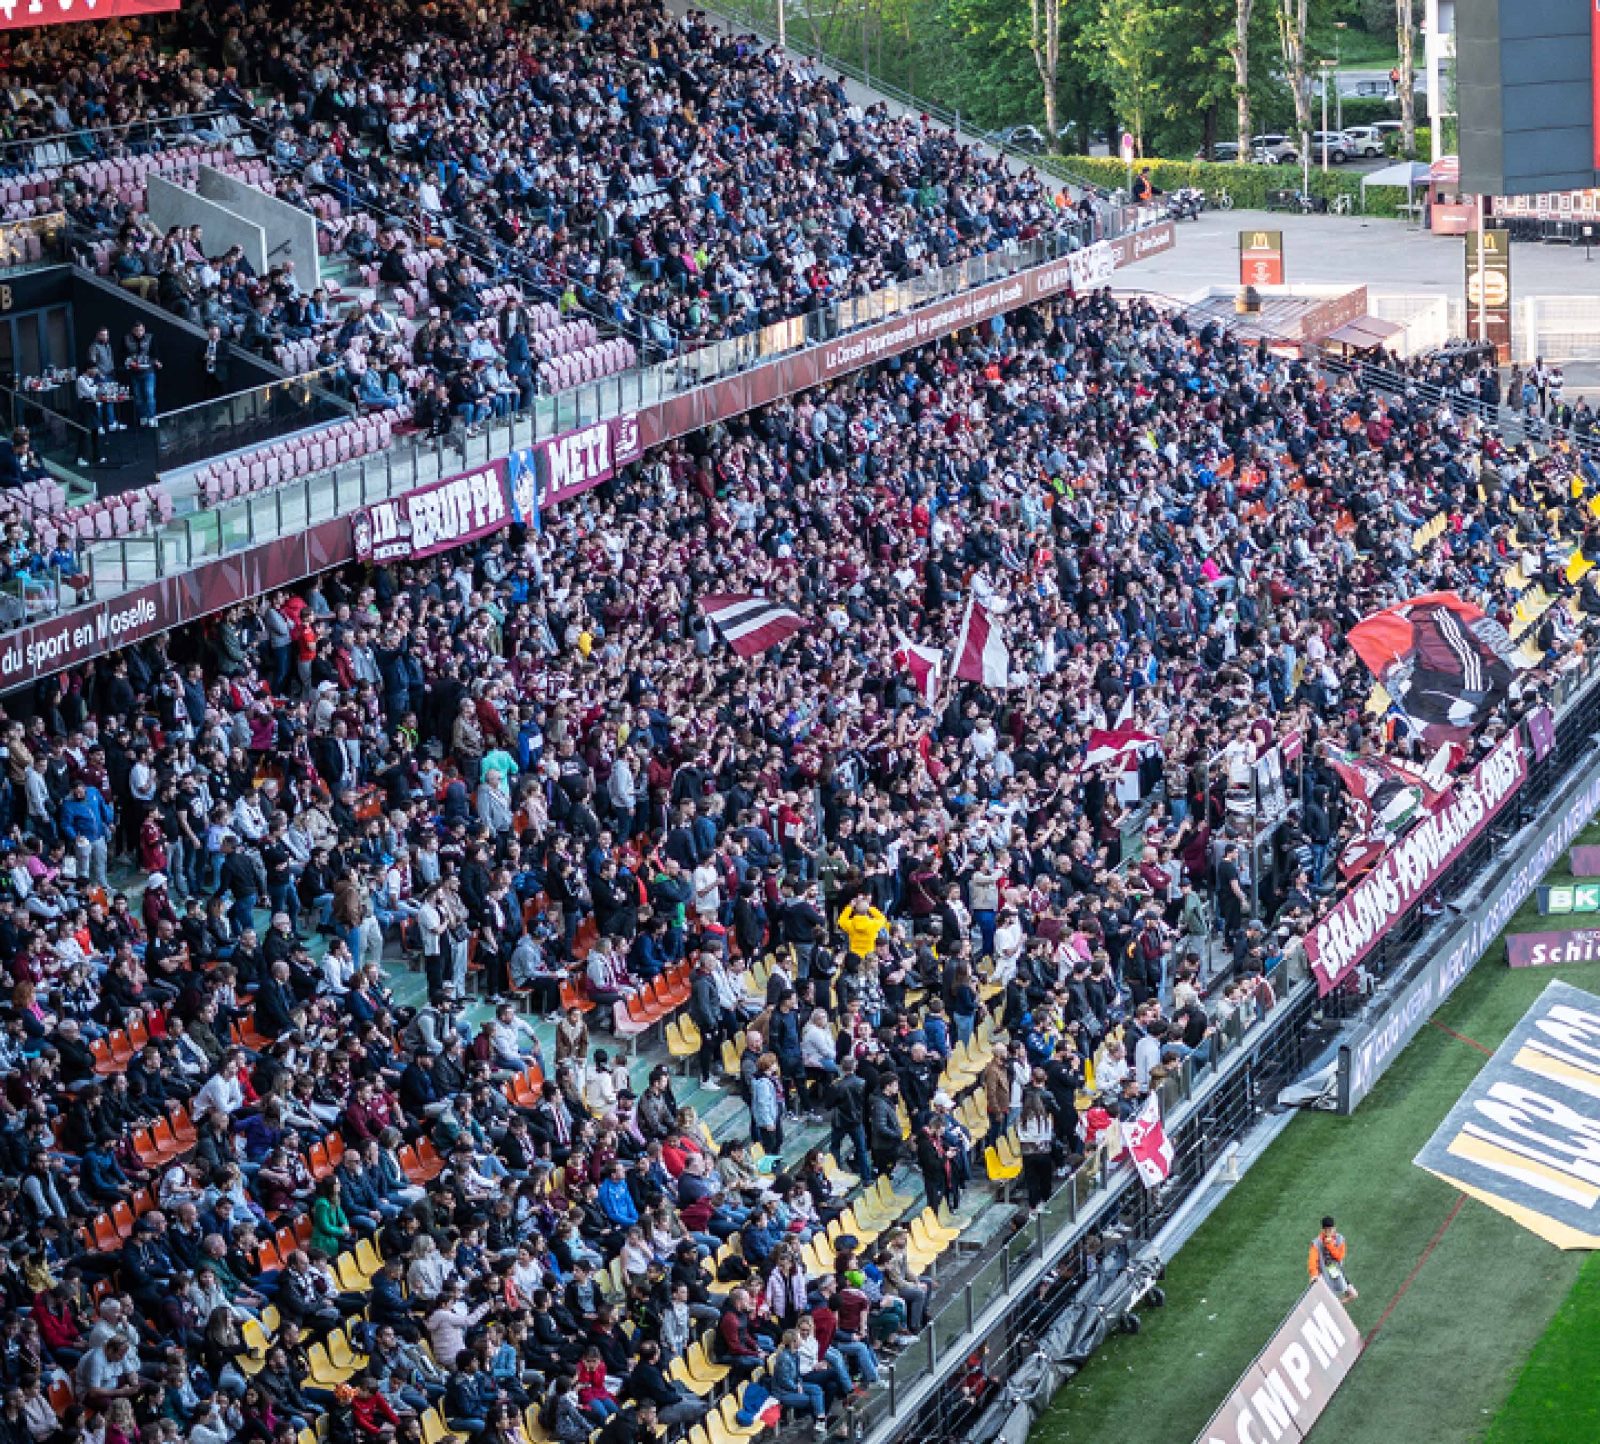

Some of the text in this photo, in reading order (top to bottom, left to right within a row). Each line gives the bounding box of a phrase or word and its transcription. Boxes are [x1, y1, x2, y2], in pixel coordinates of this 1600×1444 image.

[548, 424, 611, 493] METZ
[2, 597, 157, 675] du sport en Moselle
[1531, 939, 1600, 965] Schi
